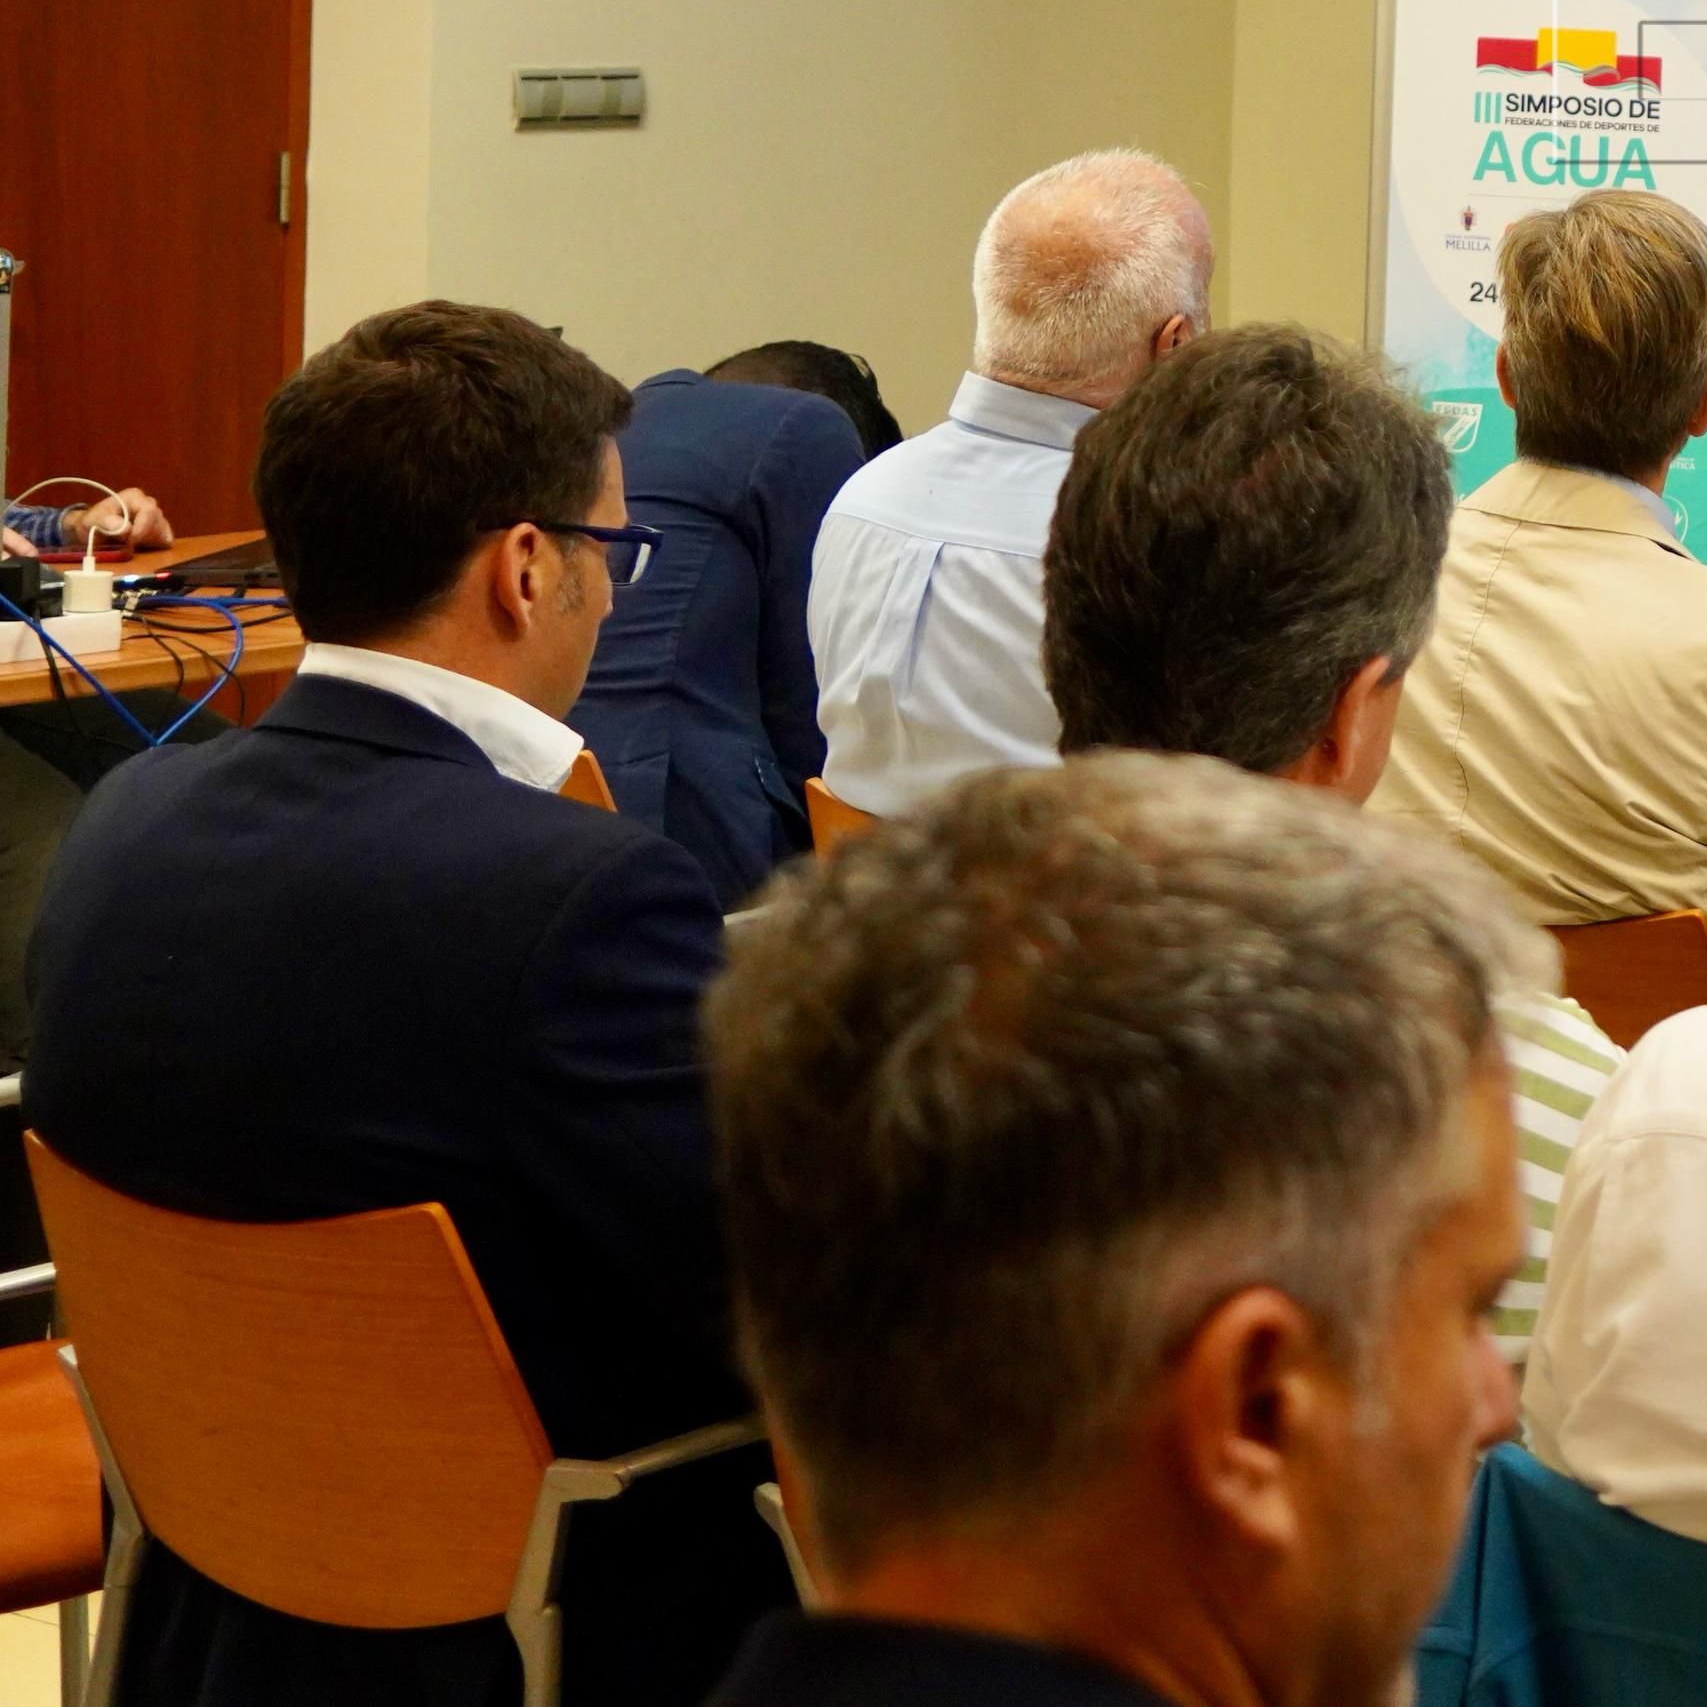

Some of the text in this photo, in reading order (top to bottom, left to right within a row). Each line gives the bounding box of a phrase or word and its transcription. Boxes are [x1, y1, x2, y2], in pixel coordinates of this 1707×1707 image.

[1474, 91, 1503, 124] III
[1505, 93, 1662, 120] SIMPOSIO DE
[1505, 116, 1660, 133] FEDERACIONES DE DEPORTES DE
[1473, 129, 1657, 191] AGUA
[1446, 239, 1492, 252] MELILLA
[1470, 281, 1499, 304] 24
